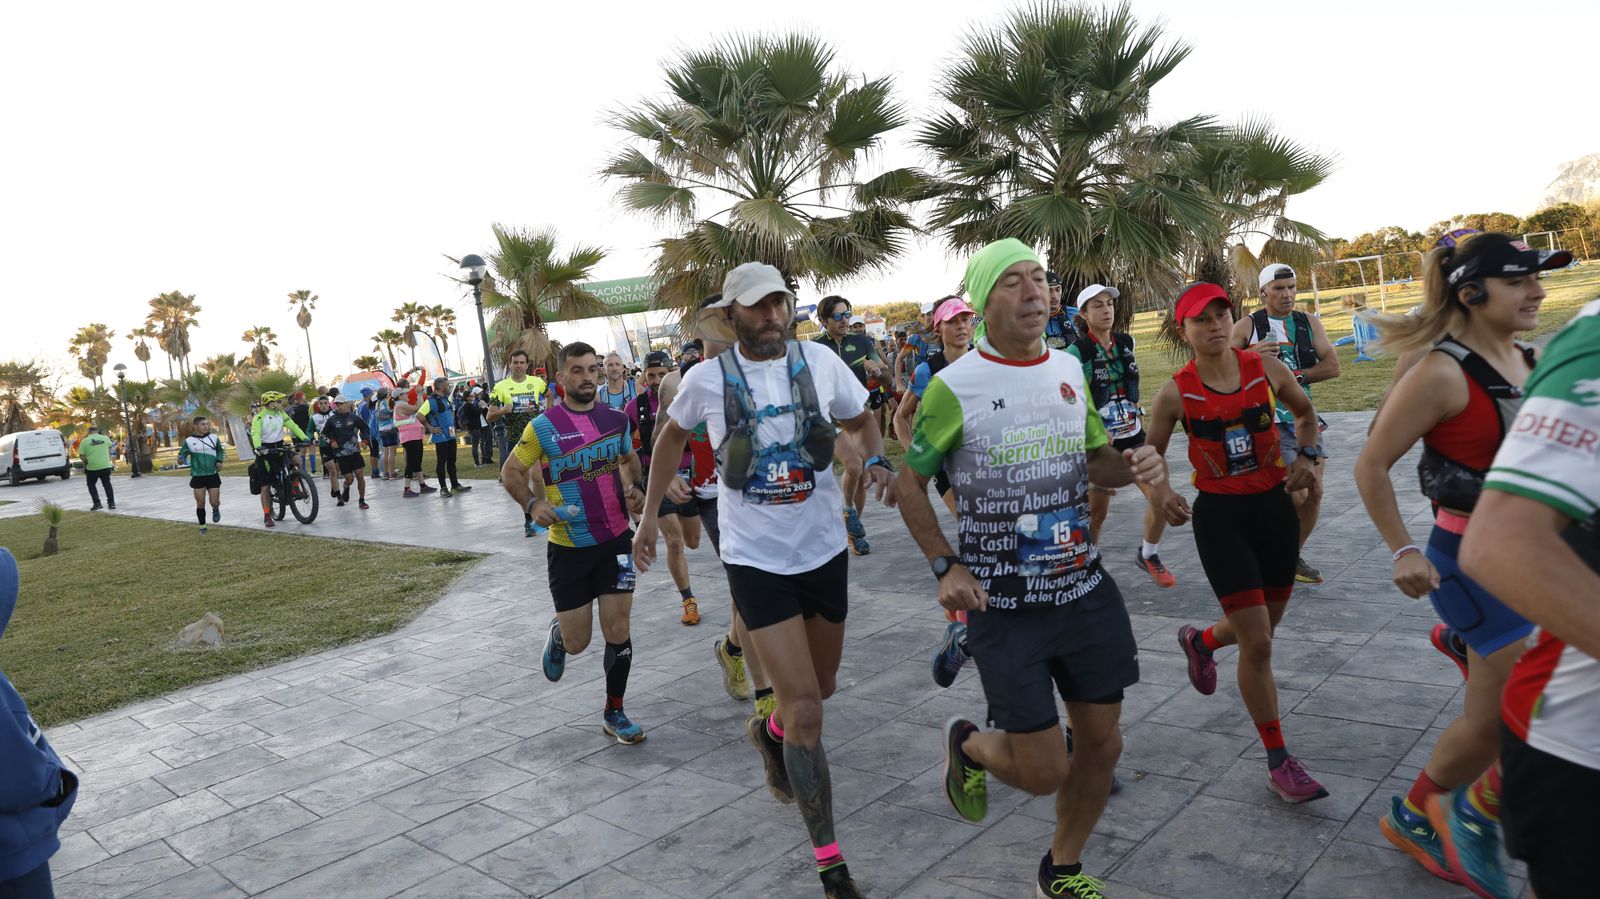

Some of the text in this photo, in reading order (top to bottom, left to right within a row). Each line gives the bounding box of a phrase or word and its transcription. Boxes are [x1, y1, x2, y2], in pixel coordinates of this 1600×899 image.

[1003, 430, 1025, 445] Club
[1027, 426, 1048, 441] Trail
[986, 441, 1041, 466] Sierra
[767, 461, 790, 481] 34
[976, 468, 987, 479] de
[989, 466, 1002, 478] los
[1007, 458, 1073, 483] Castillejos
[750, 486, 791, 494] Carbonera
[793, 481, 813, 492] 2023
[987, 485, 1026, 498] Club Trail
[976, 496, 1019, 514] Sierra
[1022, 487, 1069, 512] Abuela
[1051, 521, 1070, 544] 15
[980, 554, 998, 563] Trail
[1029, 551, 1073, 561] Carbonera
[1024, 593, 1037, 603] de
[1039, 591, 1053, 602] los
